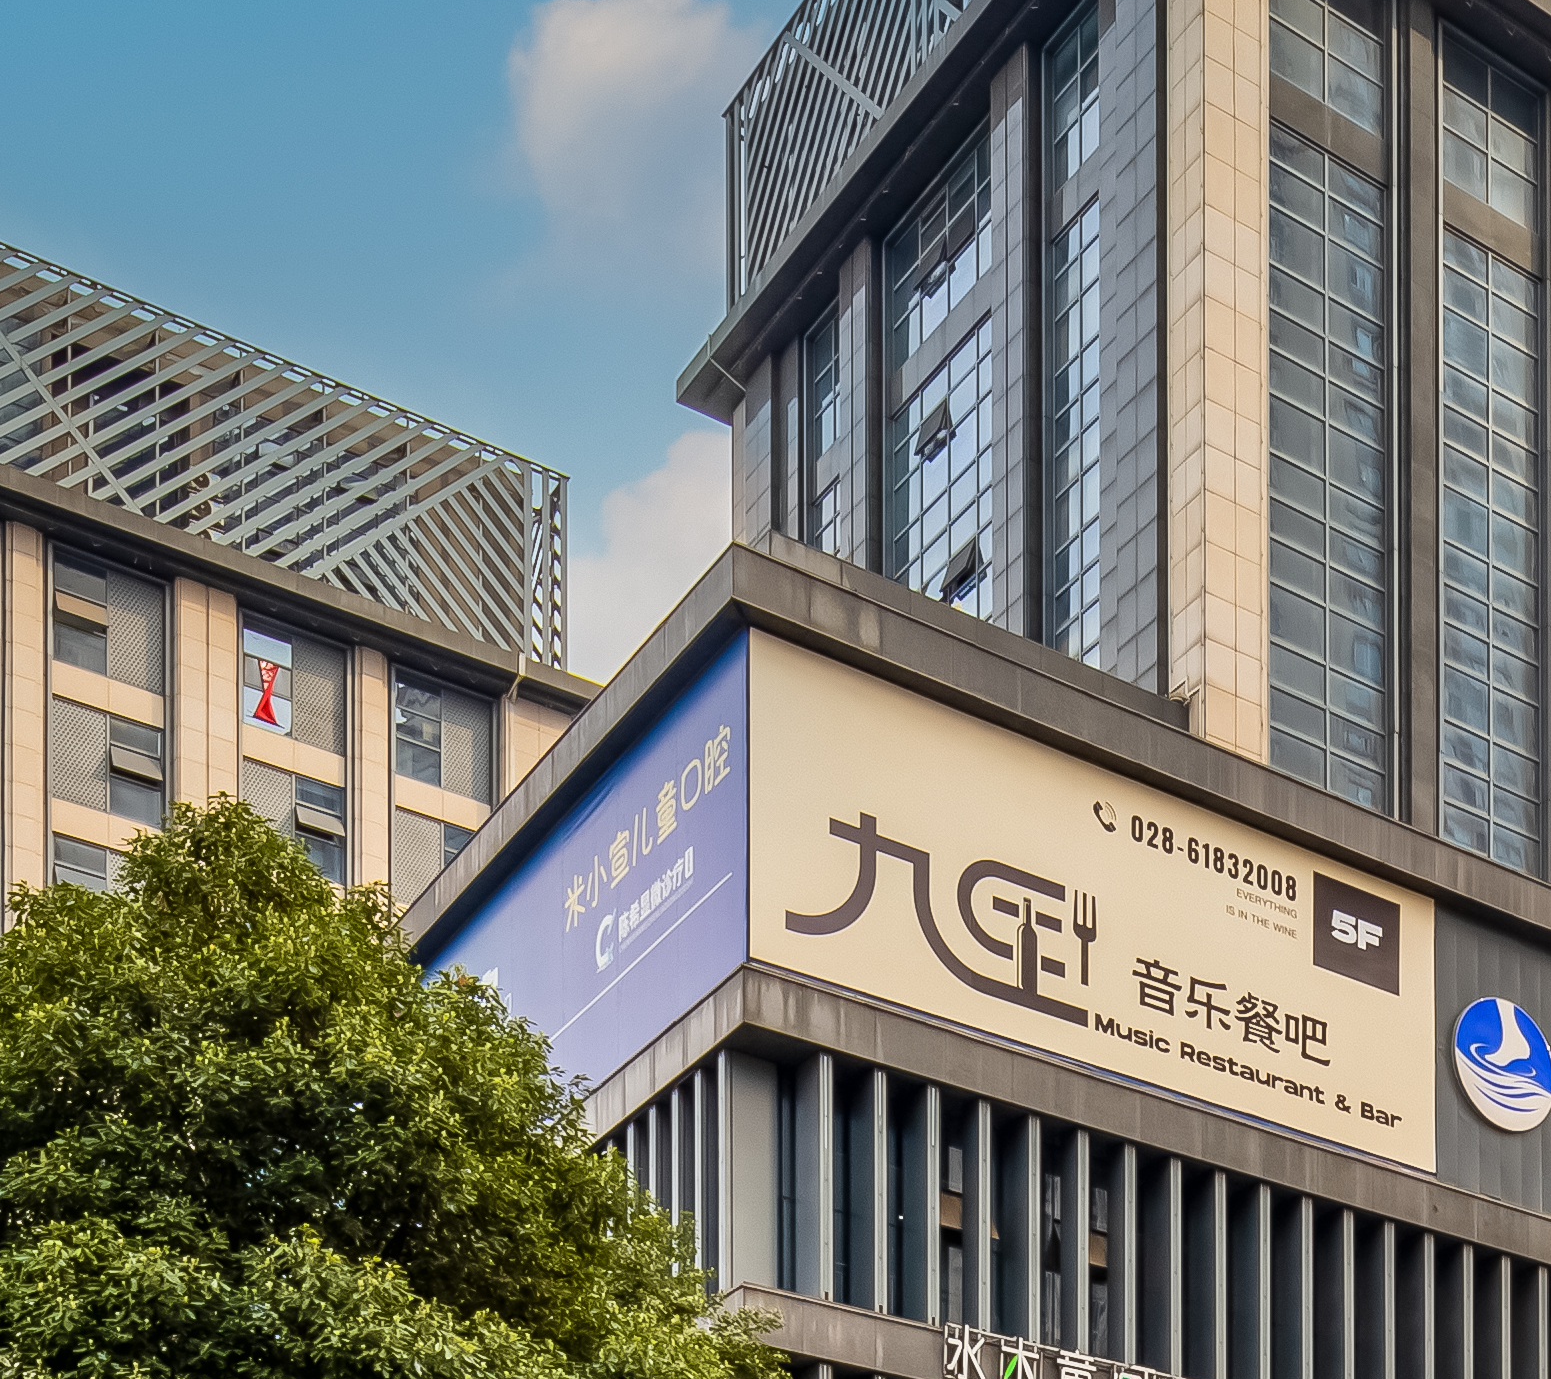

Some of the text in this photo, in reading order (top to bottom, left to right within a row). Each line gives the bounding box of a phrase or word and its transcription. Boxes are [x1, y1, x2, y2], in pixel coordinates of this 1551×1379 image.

[564, 724, 731, 933] 米小宣儿童口腔
[1130, 815, 1297, 902] 028-61832008
[1226, 904, 1297, 940] IS IN THE WINE
[1236, 887, 1297, 920] EVERYTHING
[1331, 909, 1384, 951] 5F
[1131, 957, 1331, 1067] 音乐餐吧
[1094, 1012, 1402, 1129] Music Restaurant & Bar
